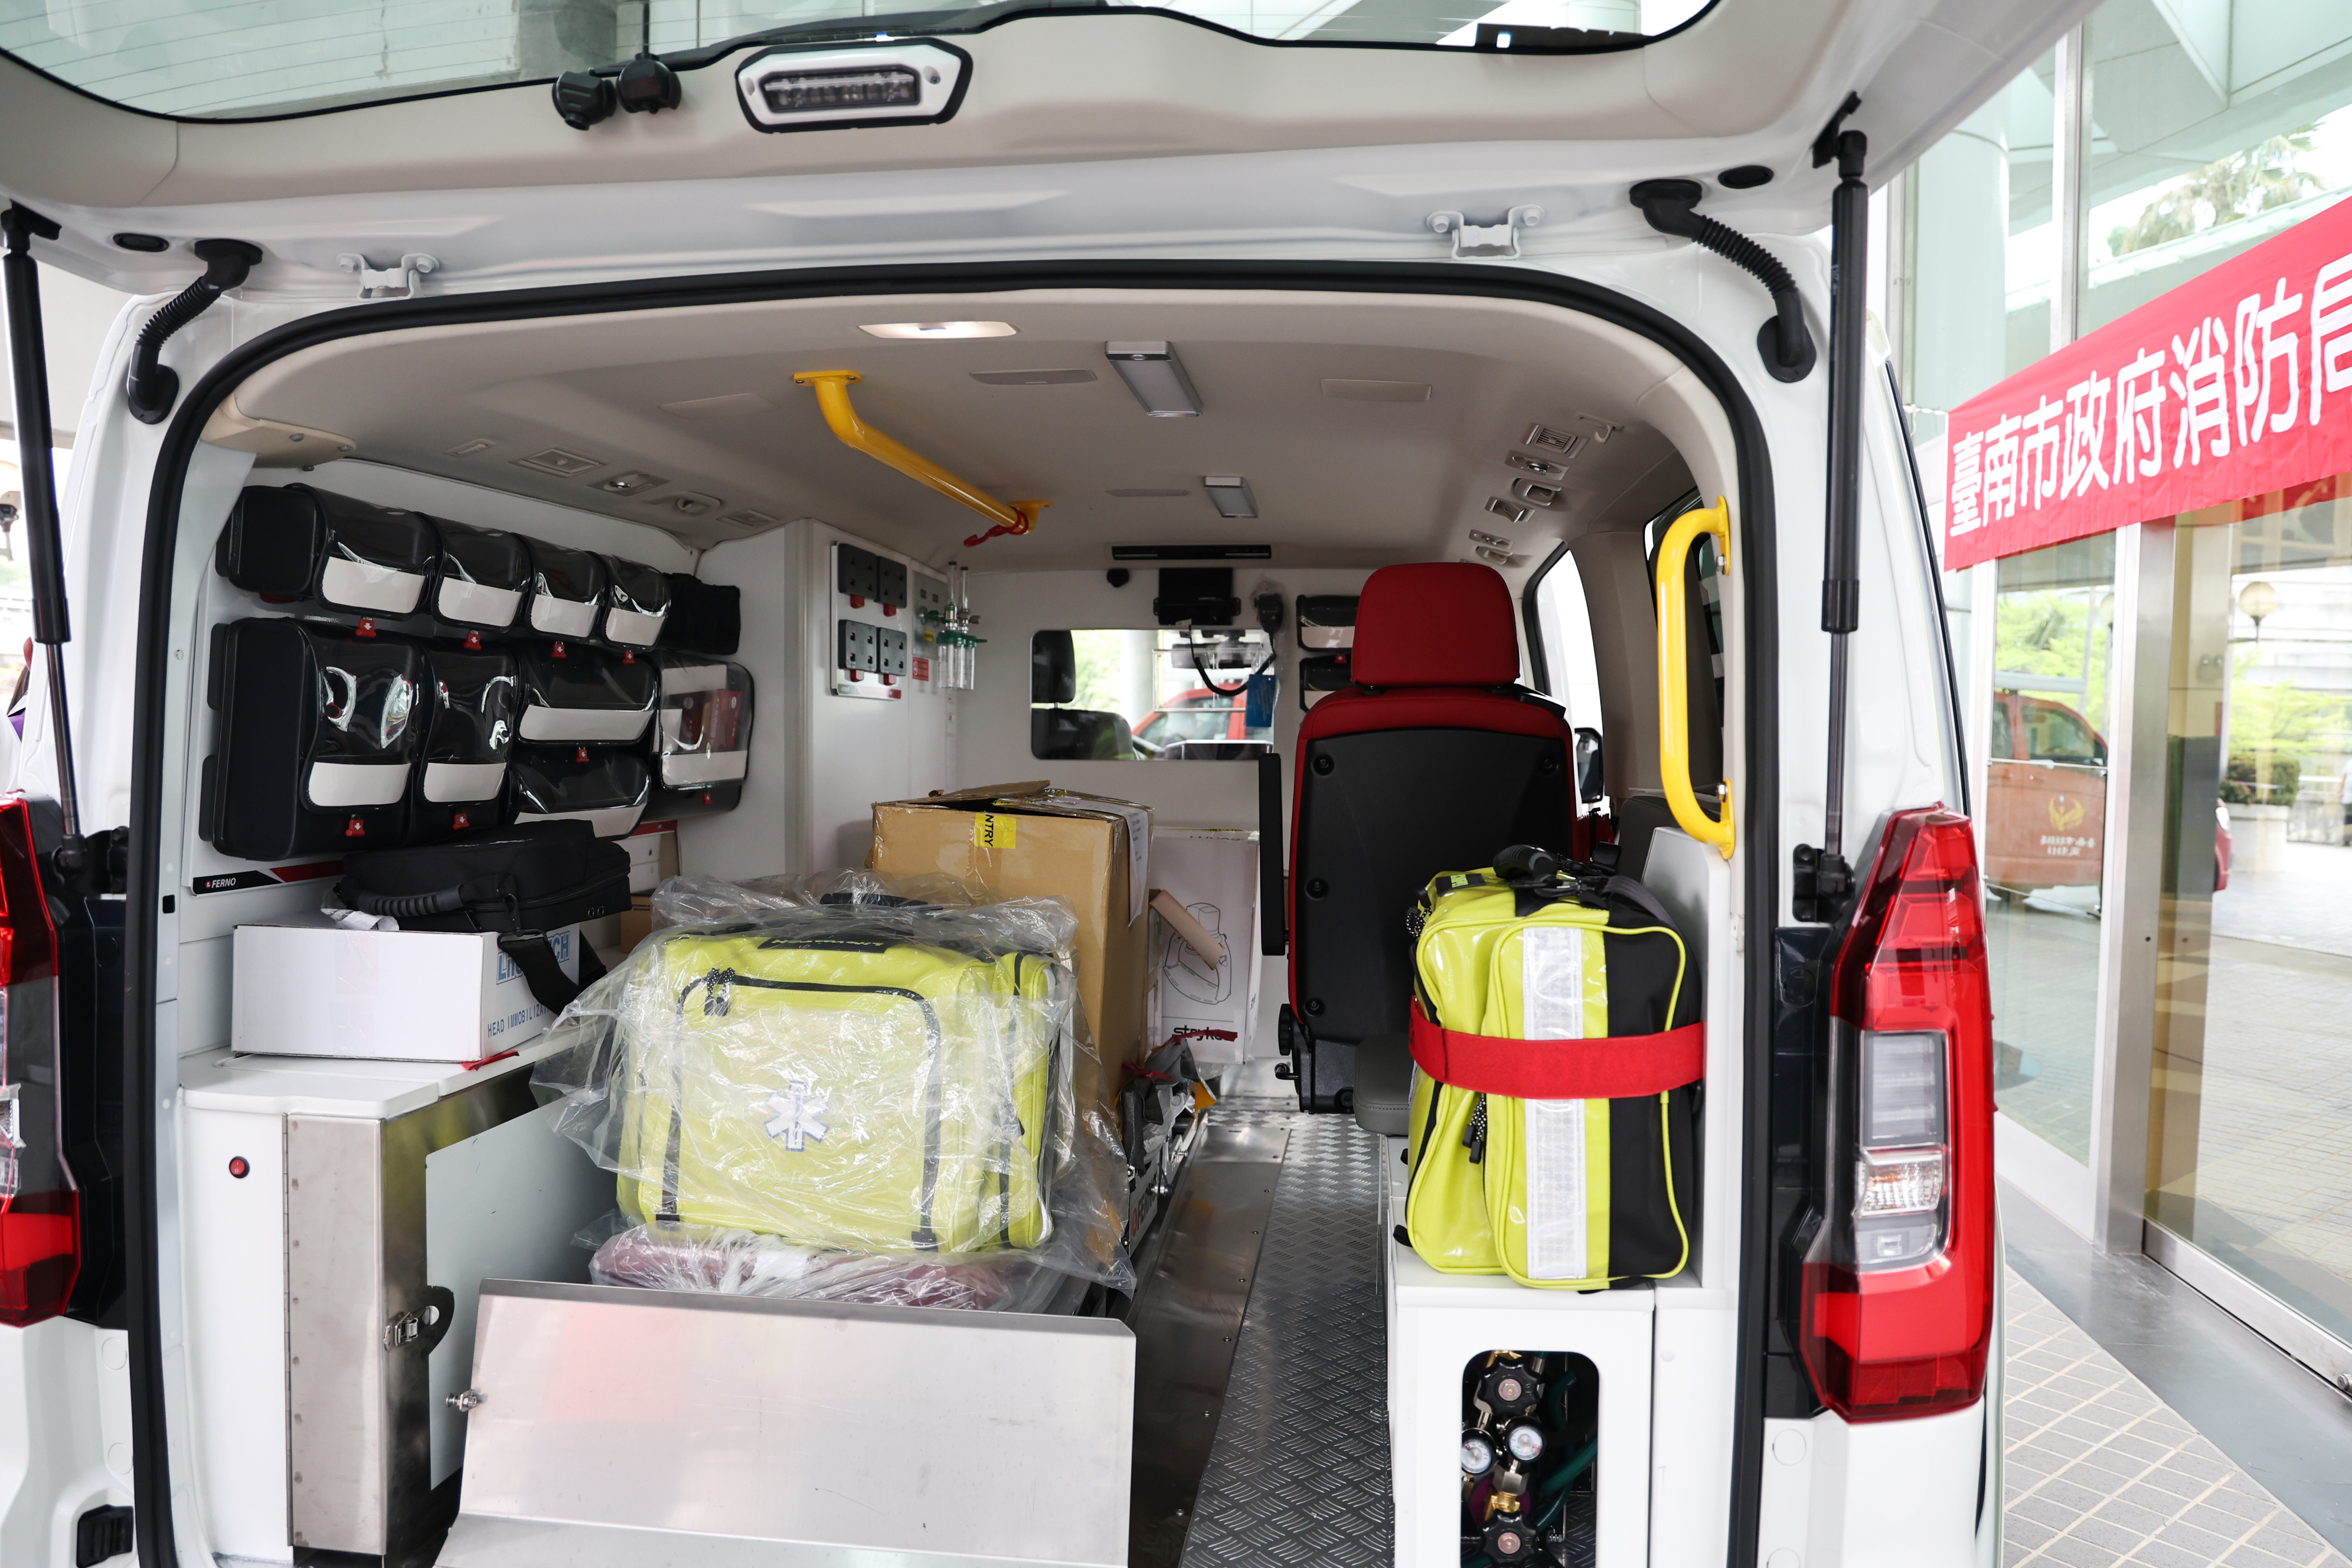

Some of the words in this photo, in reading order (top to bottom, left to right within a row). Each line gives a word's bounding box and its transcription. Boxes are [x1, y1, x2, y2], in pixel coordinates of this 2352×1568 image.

[1950, 253, 2352, 537] 臺南市政府消防局
[211, 877, 236, 888] FERNO
[488, 1019, 504, 1038] HEAD
